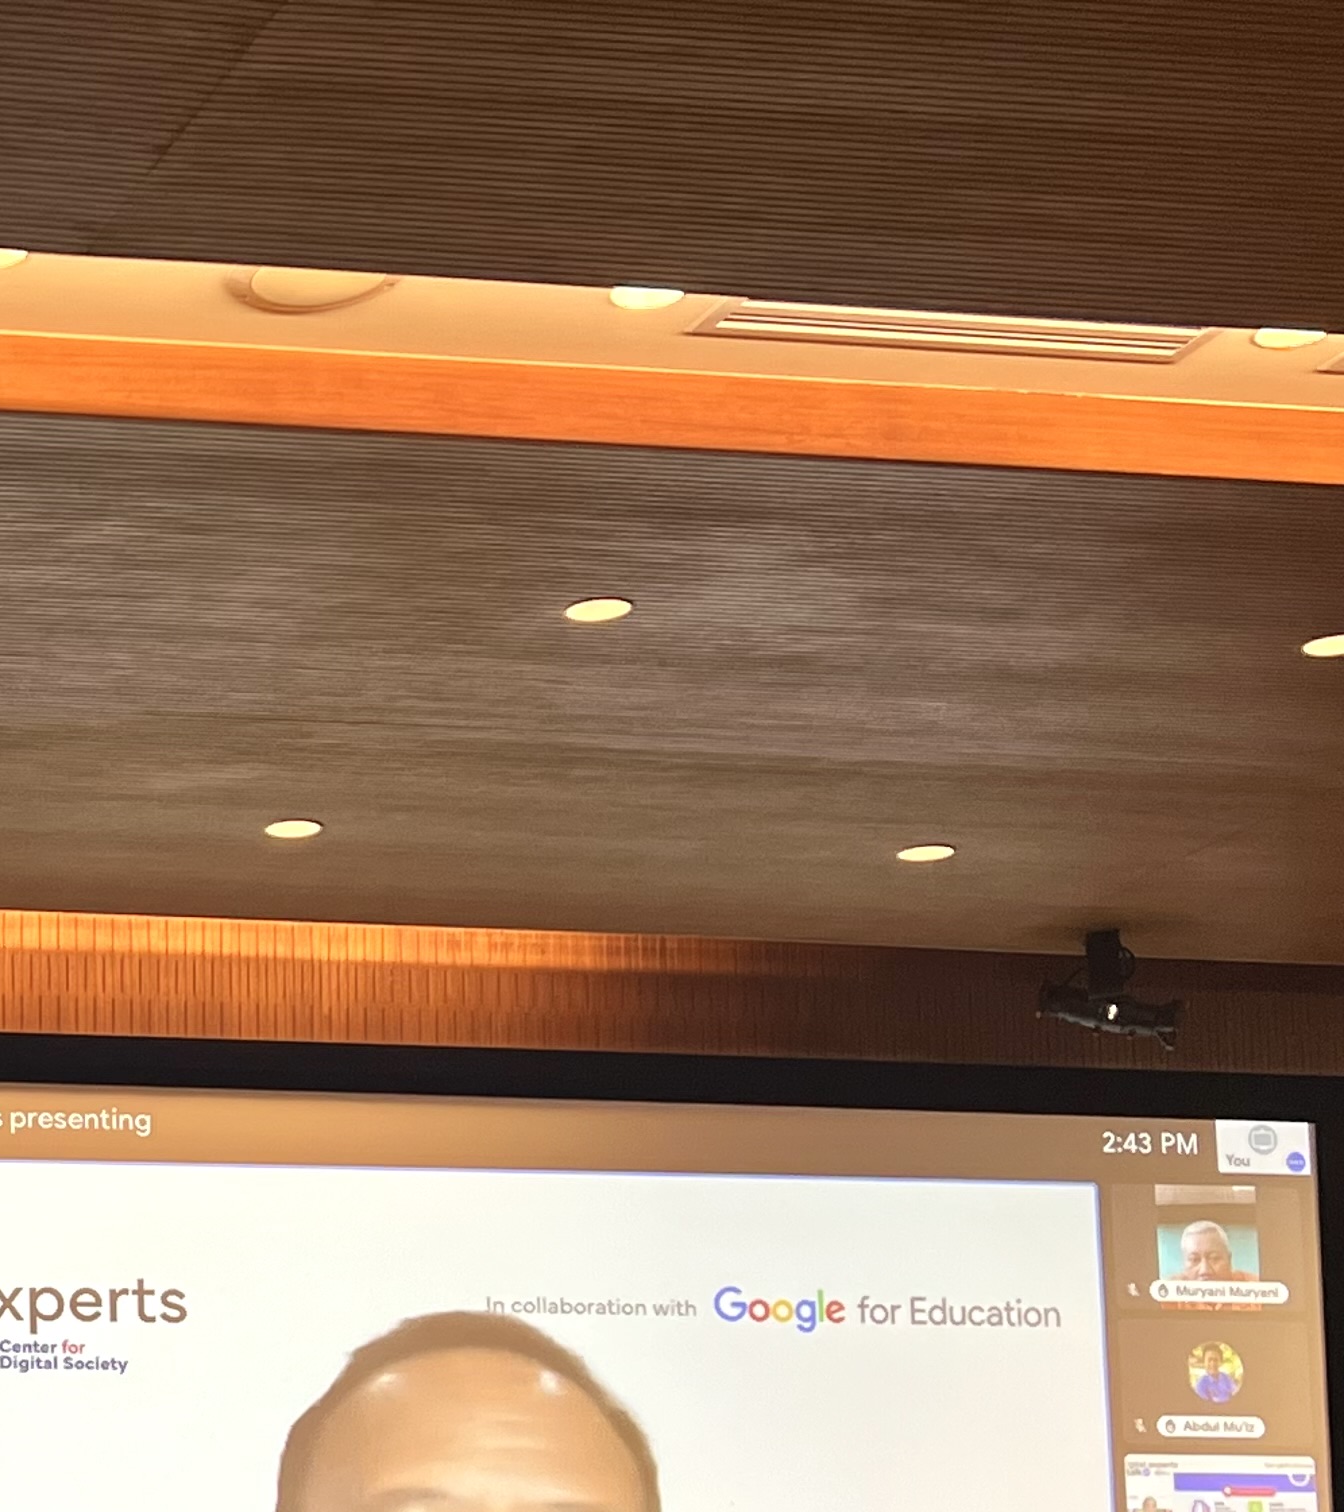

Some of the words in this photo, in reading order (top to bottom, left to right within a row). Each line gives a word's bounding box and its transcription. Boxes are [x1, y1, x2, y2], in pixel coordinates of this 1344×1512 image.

[11, 1107, 150, 1137] presenting
[1103, 1132, 1151, 1153] 2:43
[1161, 1133, 1197, 1154] PM
[1226, 1154, 1250, 1166] You
[486, 1297, 505, 1314] In
[511, 1297, 646, 1315] collaboration
[653, 1300, 696, 1316] with
[714, 1286, 845, 1333] Google
[857, 1296, 901, 1324] for
[910, 1297, 1061, 1327] Education
[0, 1339, 57, 1353] Center
[62, 1339, 85, 1354] for
[0, 1355, 57, 1373] Digital
[63, 1357, 128, 1374] Society
